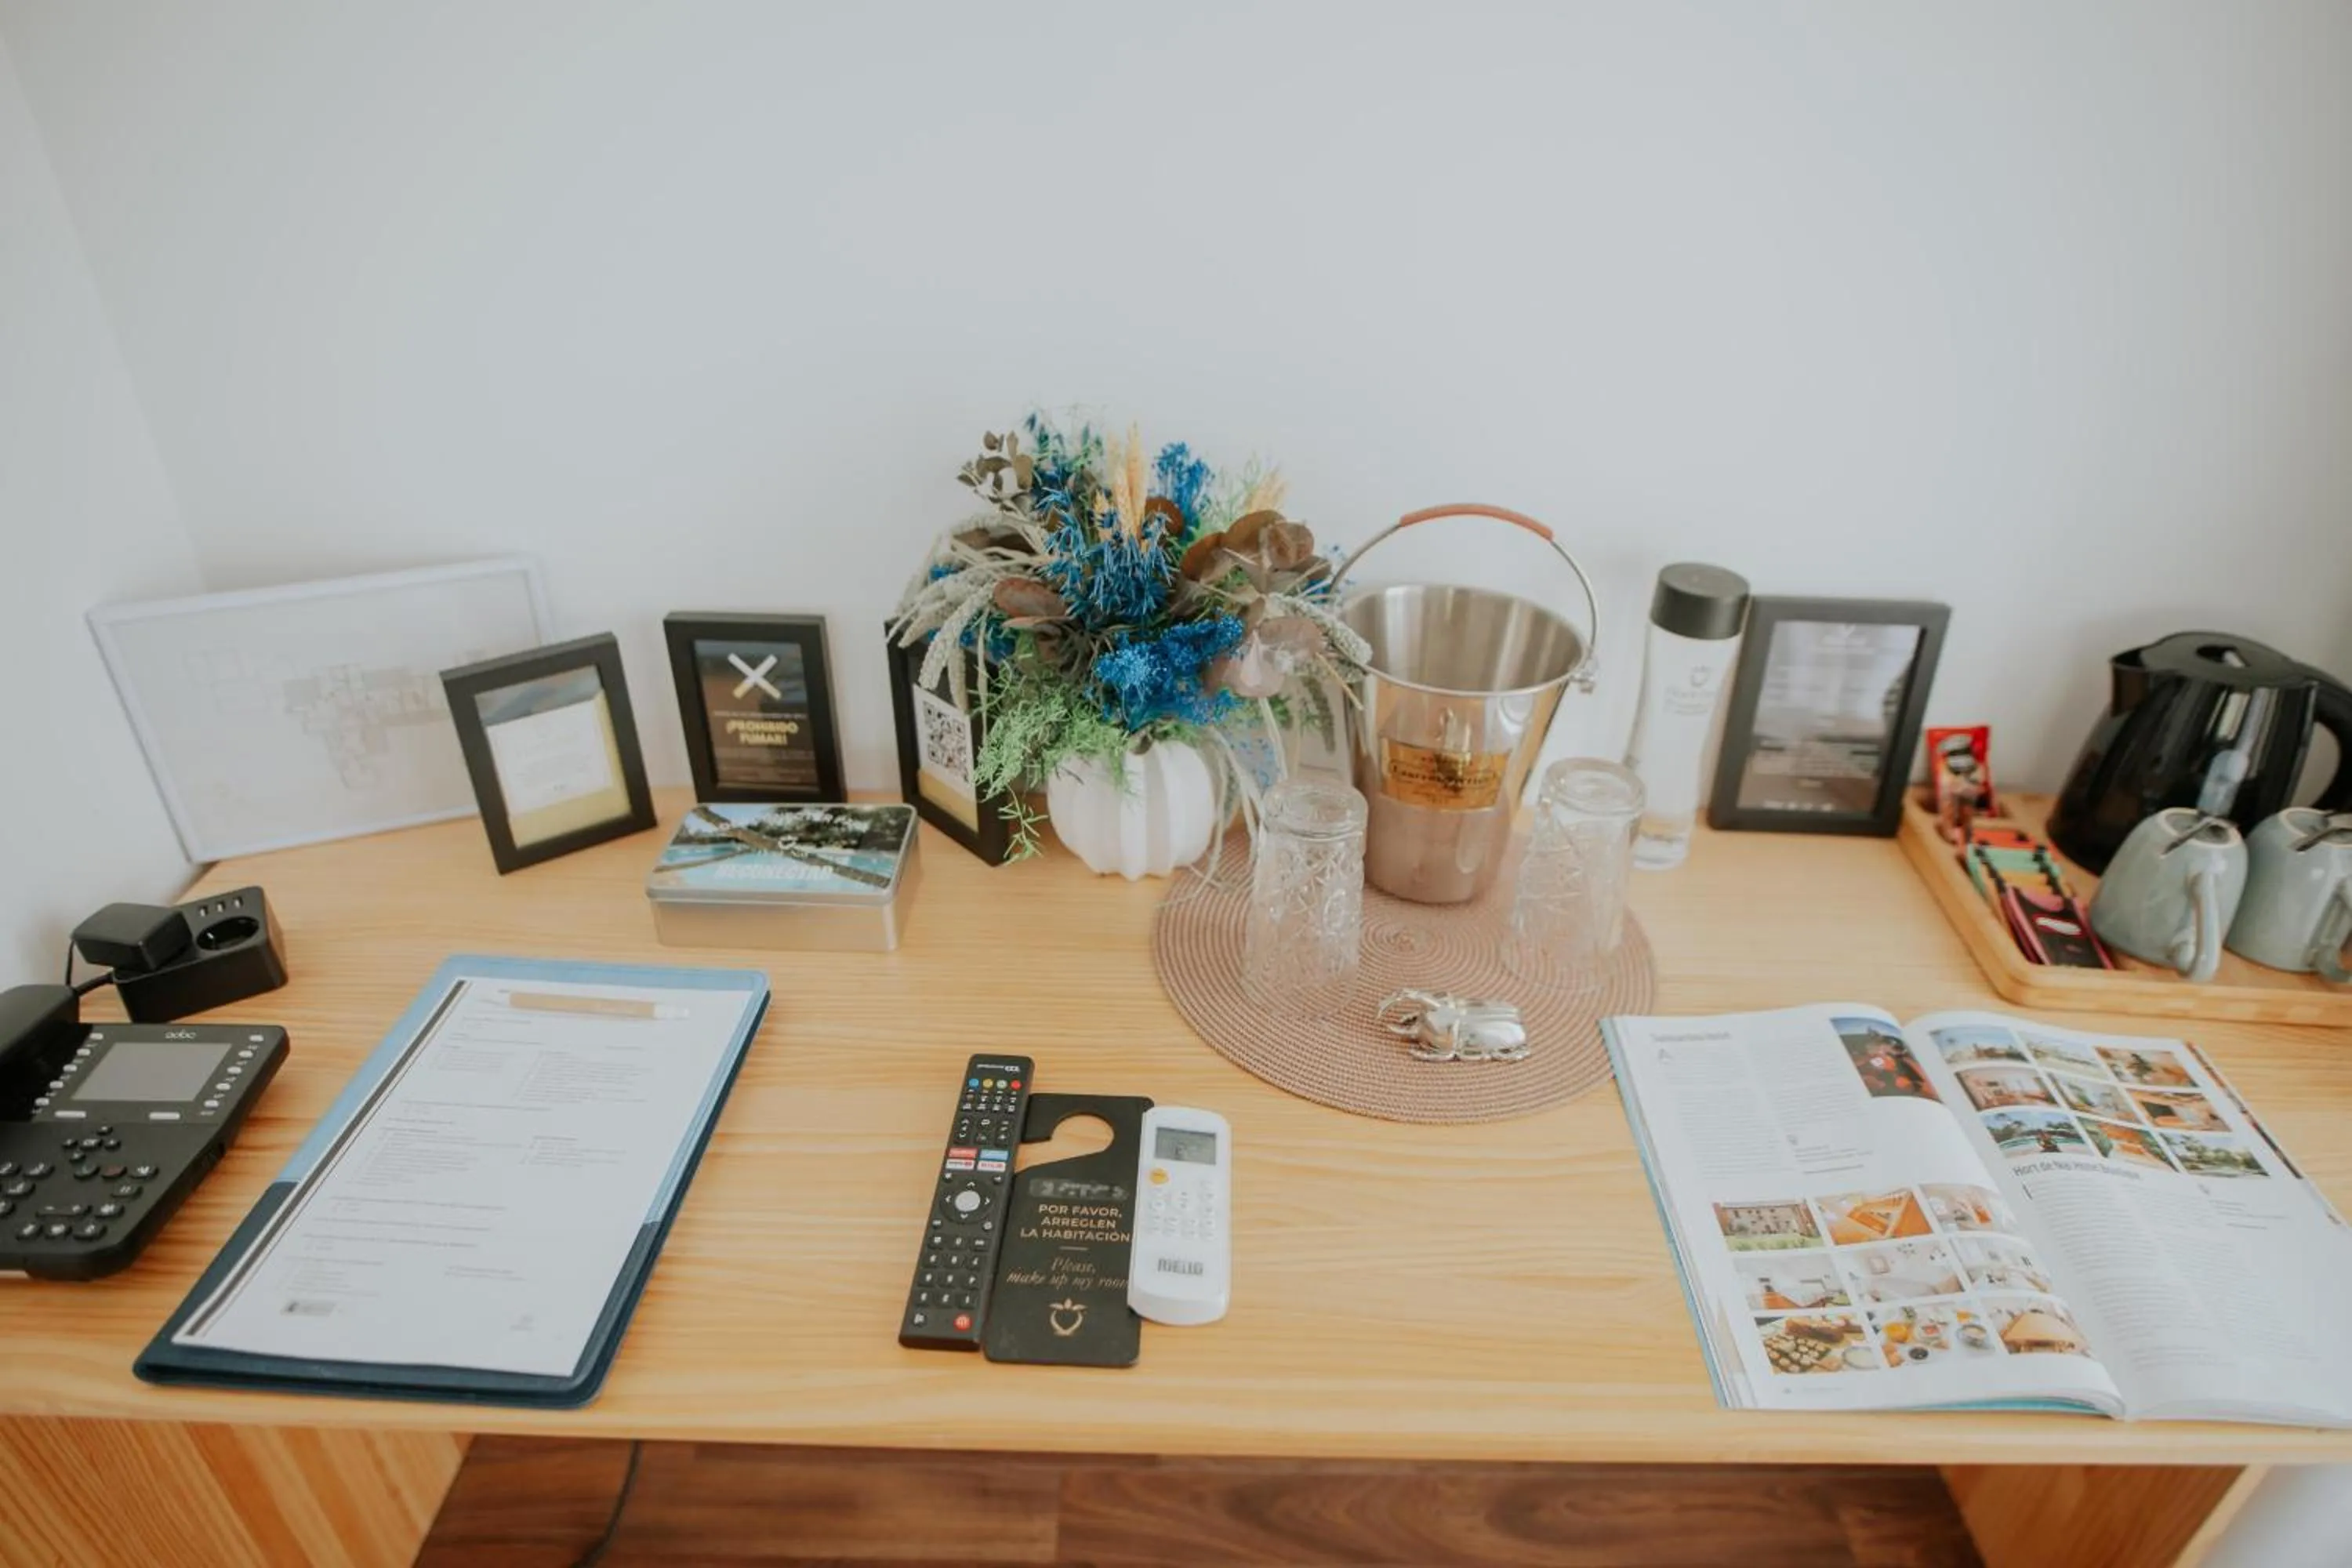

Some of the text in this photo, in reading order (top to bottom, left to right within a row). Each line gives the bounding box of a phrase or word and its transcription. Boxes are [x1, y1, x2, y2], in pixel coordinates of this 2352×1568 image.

[1039, 1203, 1122, 1218] POR FAVOR,
[1041, 1216, 1116, 1229] ARREGLEN
[1020, 1228, 1131, 1242] LA HABITACIÓN
[1007, 1271, 1045, 1284] make
[1051, 1273, 1068, 1290] up
[1072, 1276, 1093, 1290] my
